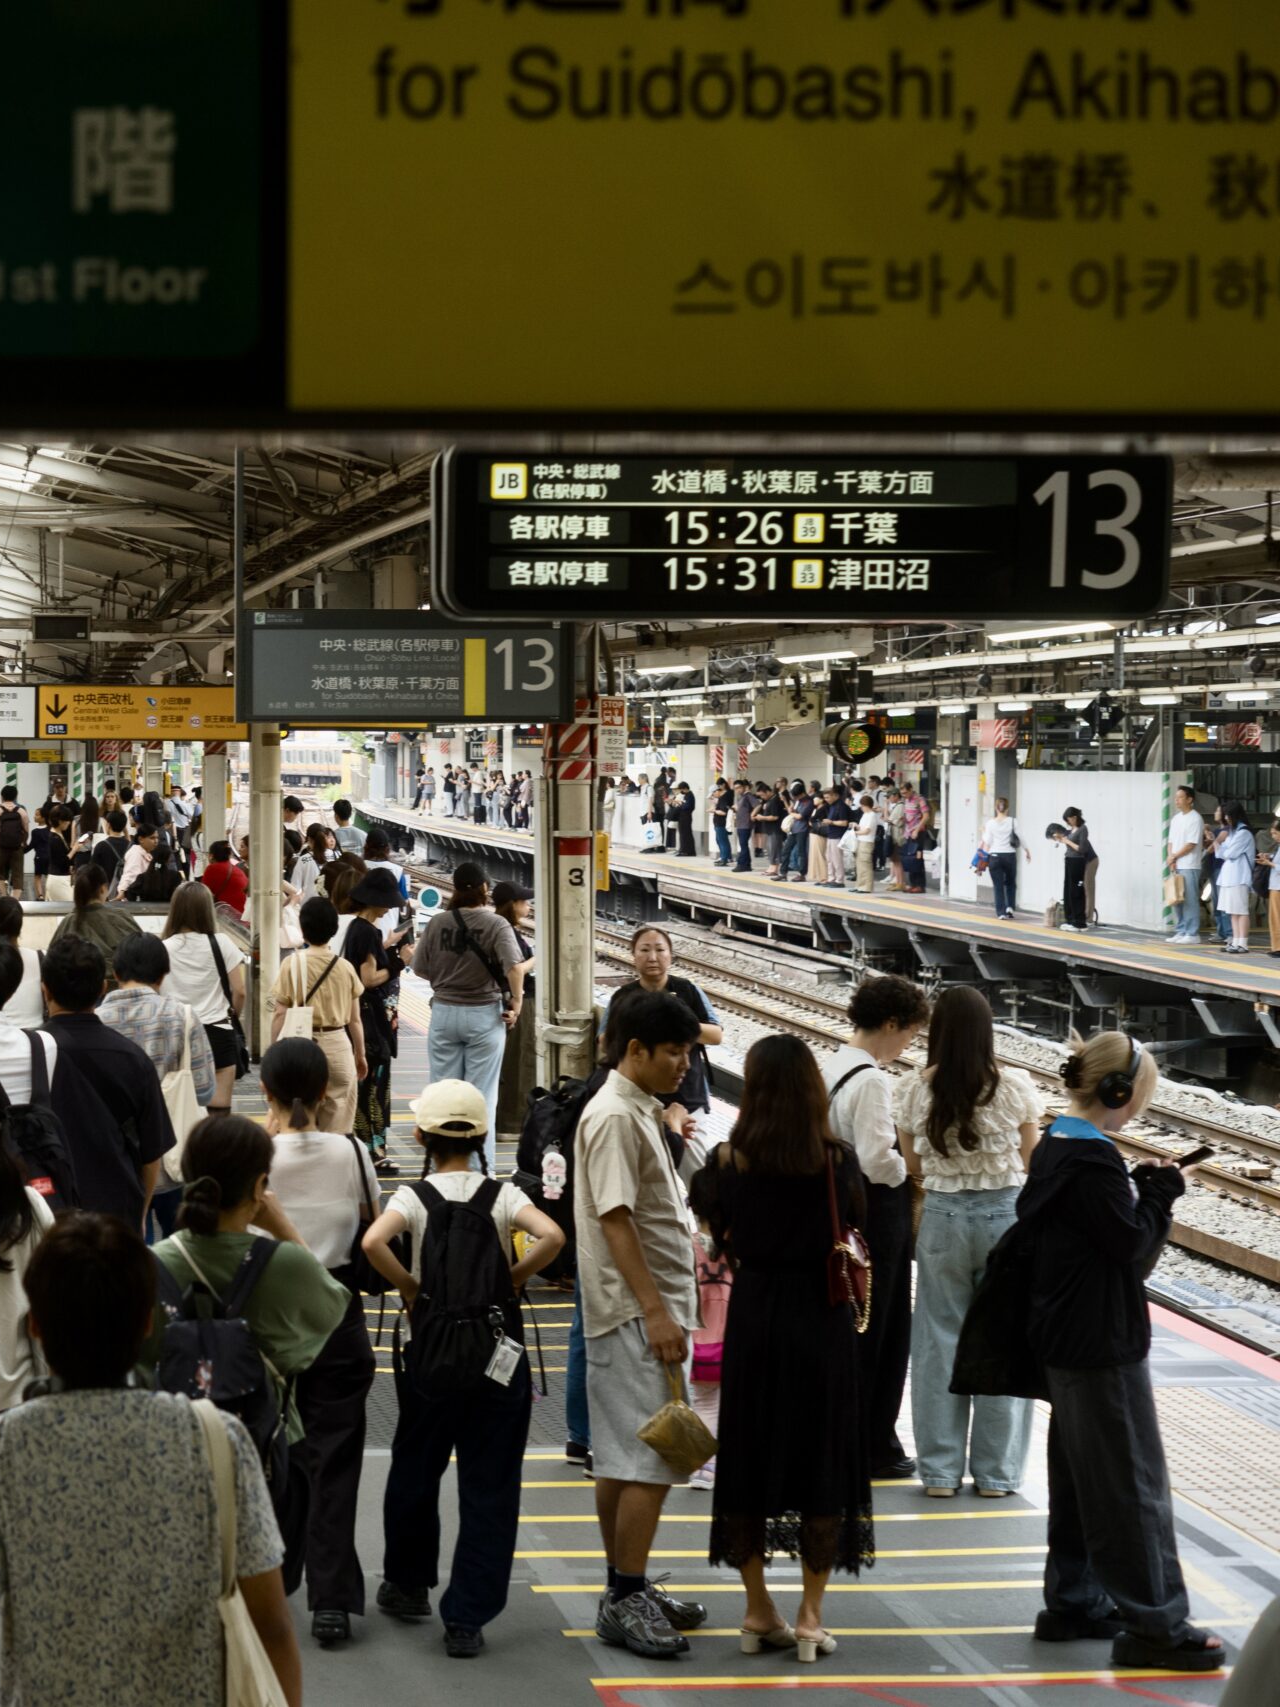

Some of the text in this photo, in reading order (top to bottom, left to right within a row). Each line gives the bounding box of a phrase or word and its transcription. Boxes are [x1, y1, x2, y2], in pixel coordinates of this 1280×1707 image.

[373, 46, 477, 121] for
[507, 45, 978, 131] Suidōbashi,
[70, 105, 179, 214] 階
[927, 151, 1280, 221] 水道桥、秋
[73, 256, 208, 304] Floor
[498, 472, 520, 489] JB
[533, 464, 621, 480] 中央・総武線
[652, 469, 934, 495] 水道橋・秋葉原・千葉方面
[532, 483, 608, 500] （各駅停車）
[509, 515, 610, 541] 各駅停車
[664, 511, 783, 545] 15:26
[830, 512, 899, 545] 千葉
[1032, 469, 1143, 590] 13
[508, 561, 609, 586] 各駅停車
[663, 557, 777, 591] 15:31
[828, 558, 931, 592] 津田沼
[319, 638, 460, 652] 中央・総武線（各駅停車）
[493, 637, 556, 692] 13
[311, 677, 459, 691] 水道橋・秋葉原・千葉方面
[73, 693, 134, 706] 中央西改札
[569, 868, 584, 886] 3
